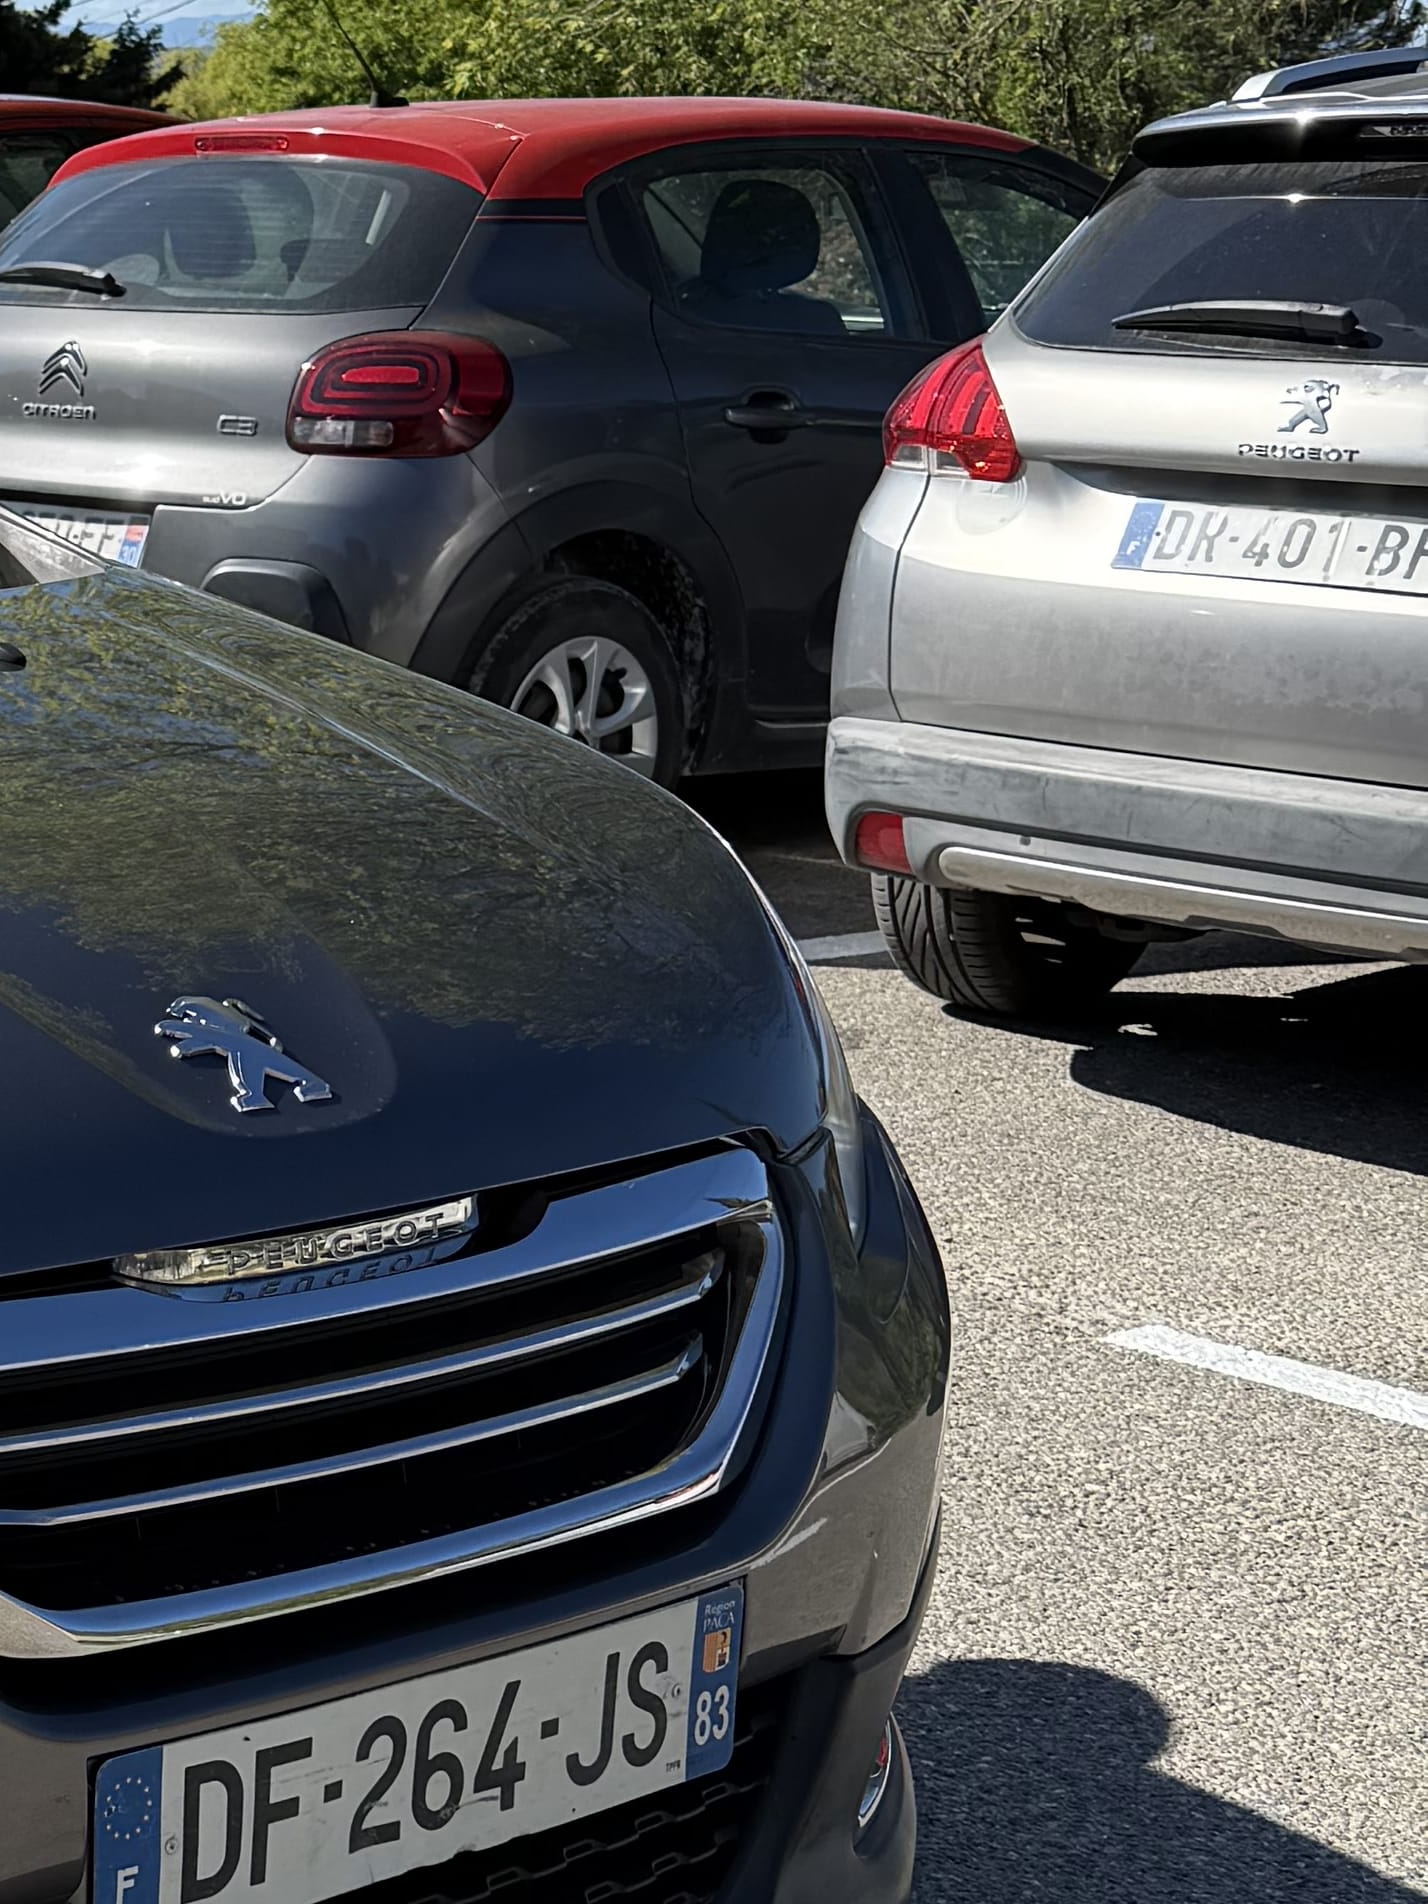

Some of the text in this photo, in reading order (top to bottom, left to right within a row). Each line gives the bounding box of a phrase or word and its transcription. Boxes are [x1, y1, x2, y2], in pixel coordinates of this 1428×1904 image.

[216, 414, 258, 436] C3
[1238, 443, 1360, 462] PEUGEOT
[226, 1212, 445, 1275] PEUGEOT
[694, 1684, 730, 1746] 83
